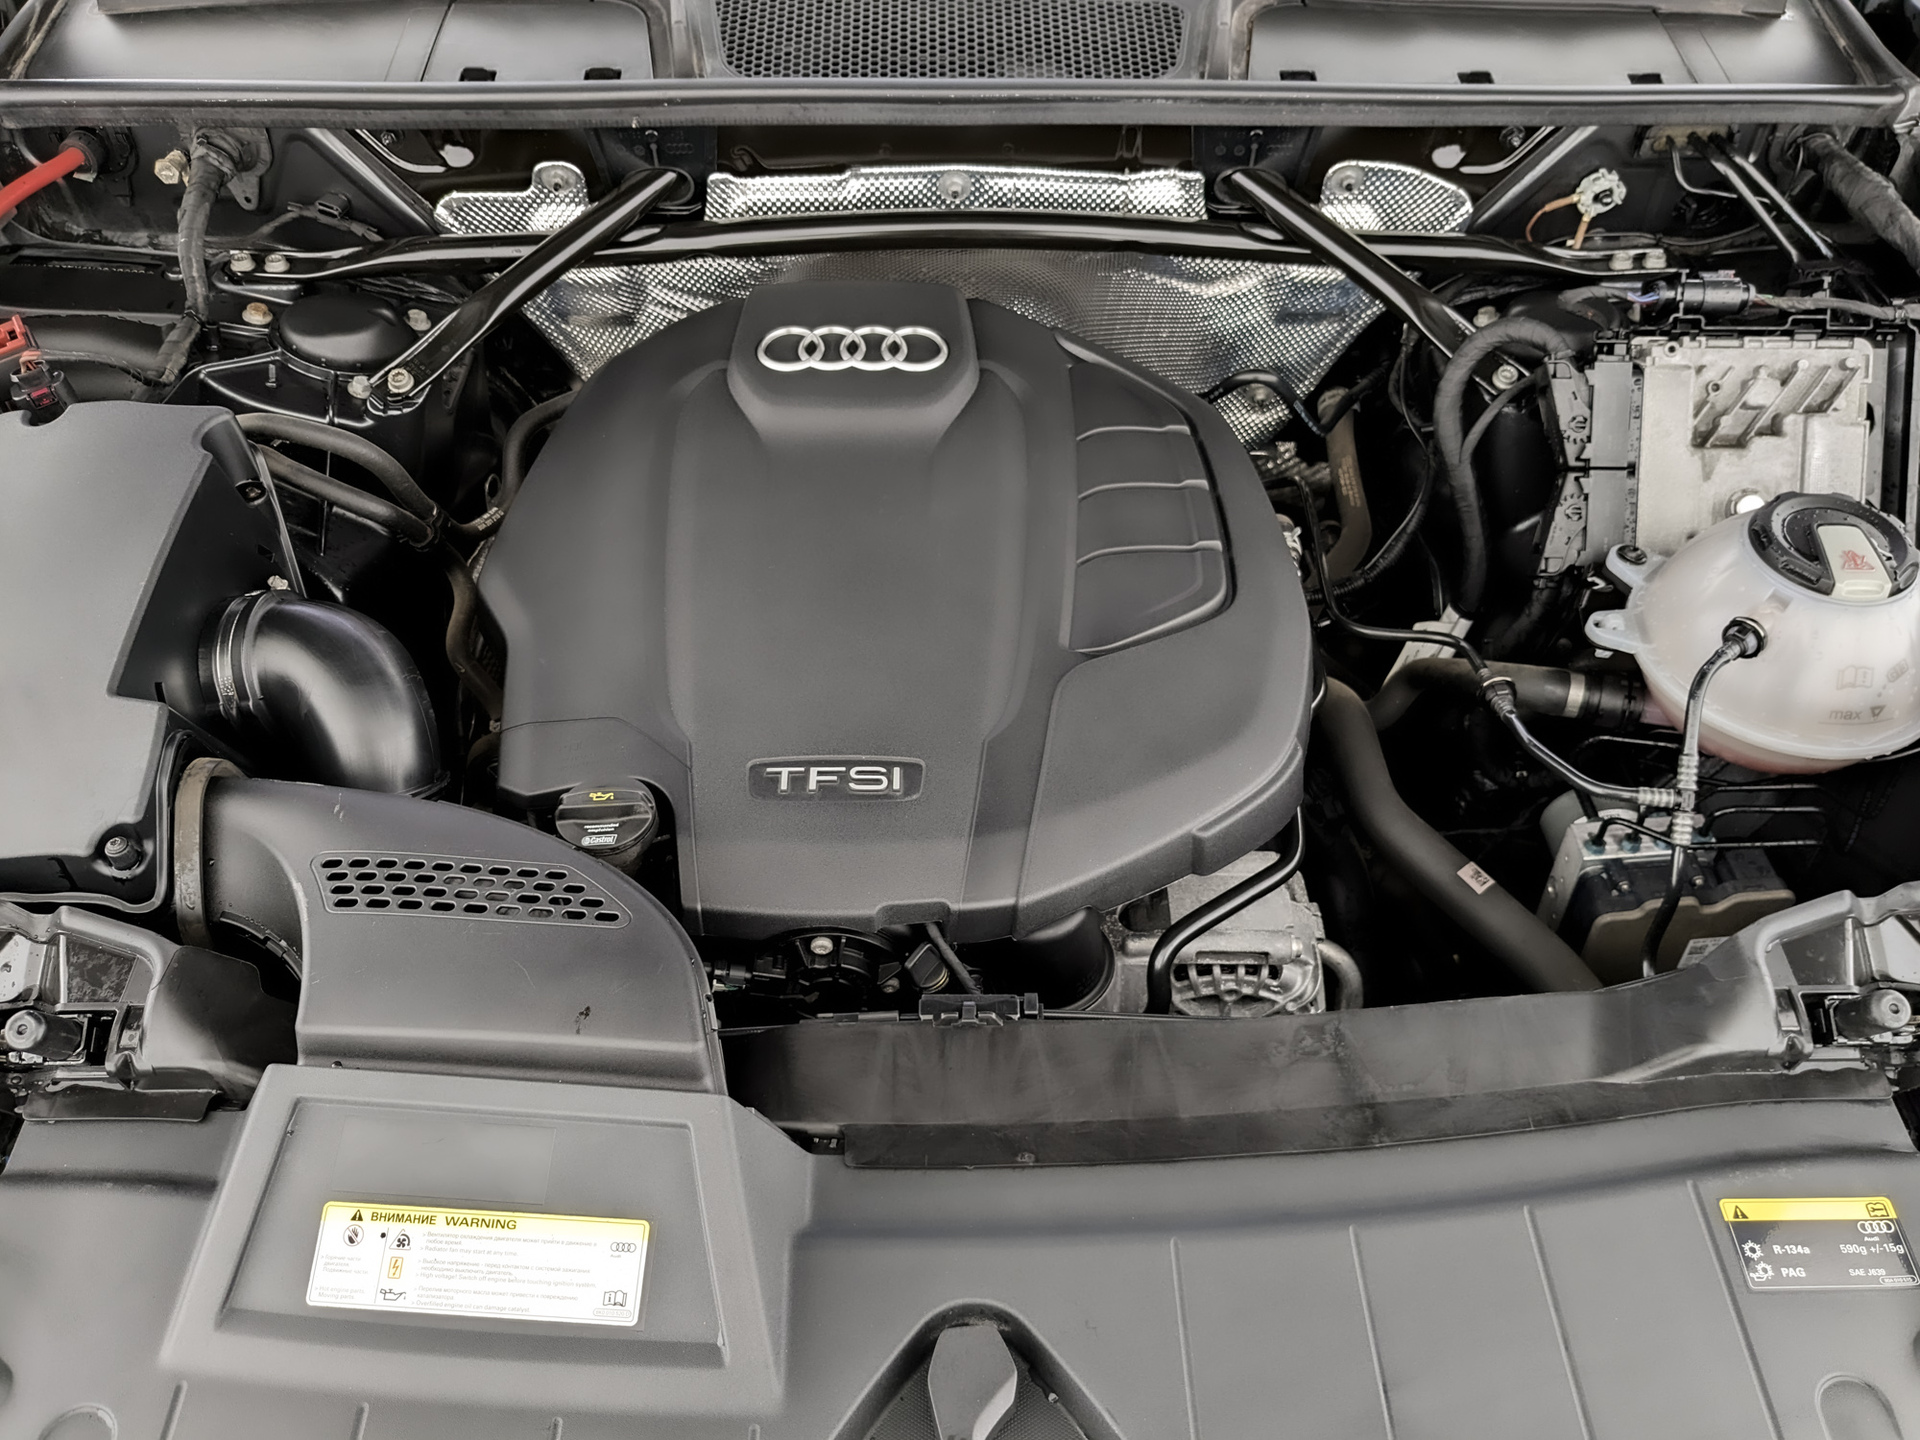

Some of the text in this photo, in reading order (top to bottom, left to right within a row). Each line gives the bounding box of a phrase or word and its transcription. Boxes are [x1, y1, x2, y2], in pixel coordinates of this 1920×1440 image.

[1829, 710, 1863, 720] max
[766, 767, 901, 791] TFSI
[591, 835, 613, 844] Castrol
[370, 1211, 437, 1226] ВНИМАНИЕ
[445, 1215, 517, 1230] WARNING
[424, 1245, 448, 1253] Radiator
[449, 1246, 458, 1254] fan
[1772, 1243, 1905, 1256] R-134a 590g +/-15g
[1781, 1267, 1886, 1278] PAG SAE J639
[527, 1279, 551, 1287] touching
[553, 1280, 574, 1288] ignition
